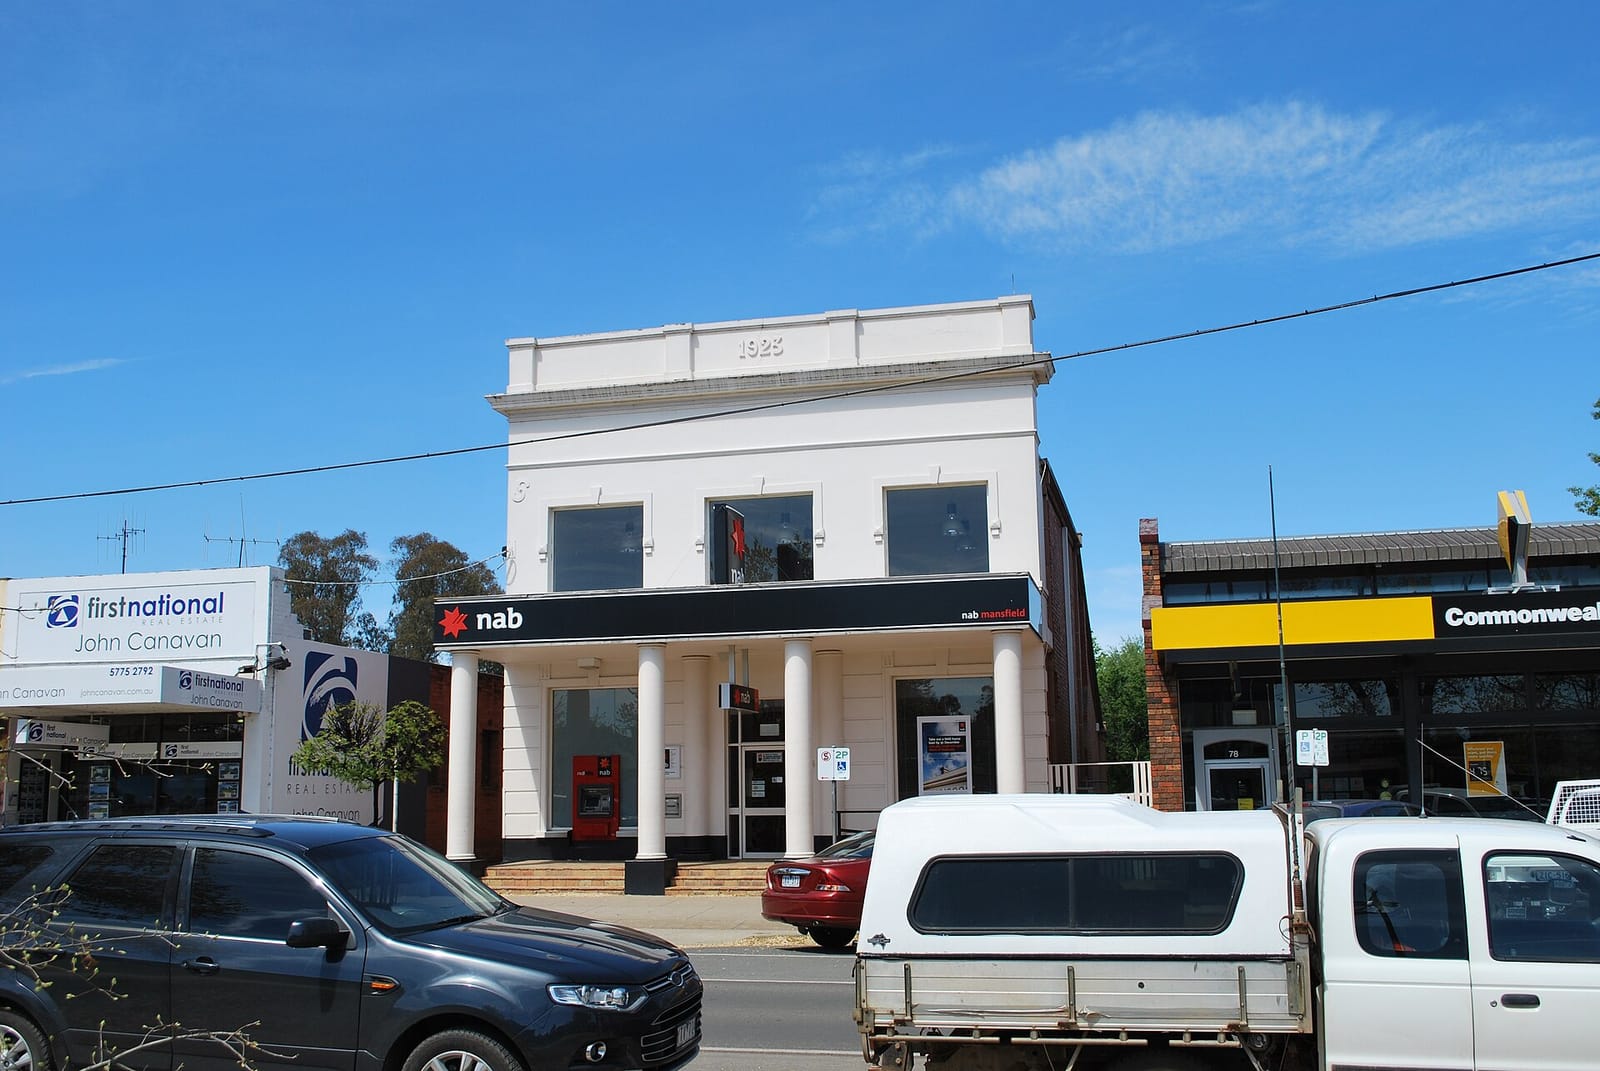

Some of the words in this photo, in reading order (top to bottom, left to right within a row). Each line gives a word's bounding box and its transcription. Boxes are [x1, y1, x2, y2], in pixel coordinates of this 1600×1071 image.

[739, 336, 784, 359] 1923
[87, 591, 225, 619] firstnational
[476, 607, 523, 630] nab
[961, 610, 979, 620] nab
[981, 608, 1026, 619] mansfield
[142, 618, 171, 626] REAL
[180, 616, 223, 625] ESTATE
[75, 633, 121, 653] John
[127, 631, 222, 651] Canavan
[109, 667, 130, 677] 5775
[132, 666, 154, 676] 2792
[195, 674, 244, 692] firstnational
[12, 687, 66, 699] Canavan
[190, 694, 208, 705] John
[209, 695, 243, 709] Canavan
[1315, 731, 1327, 741] 2P
[835, 751, 849, 759] 2P
[1228, 750, 1240, 758] 78
[286, 783, 316, 795] REAL
